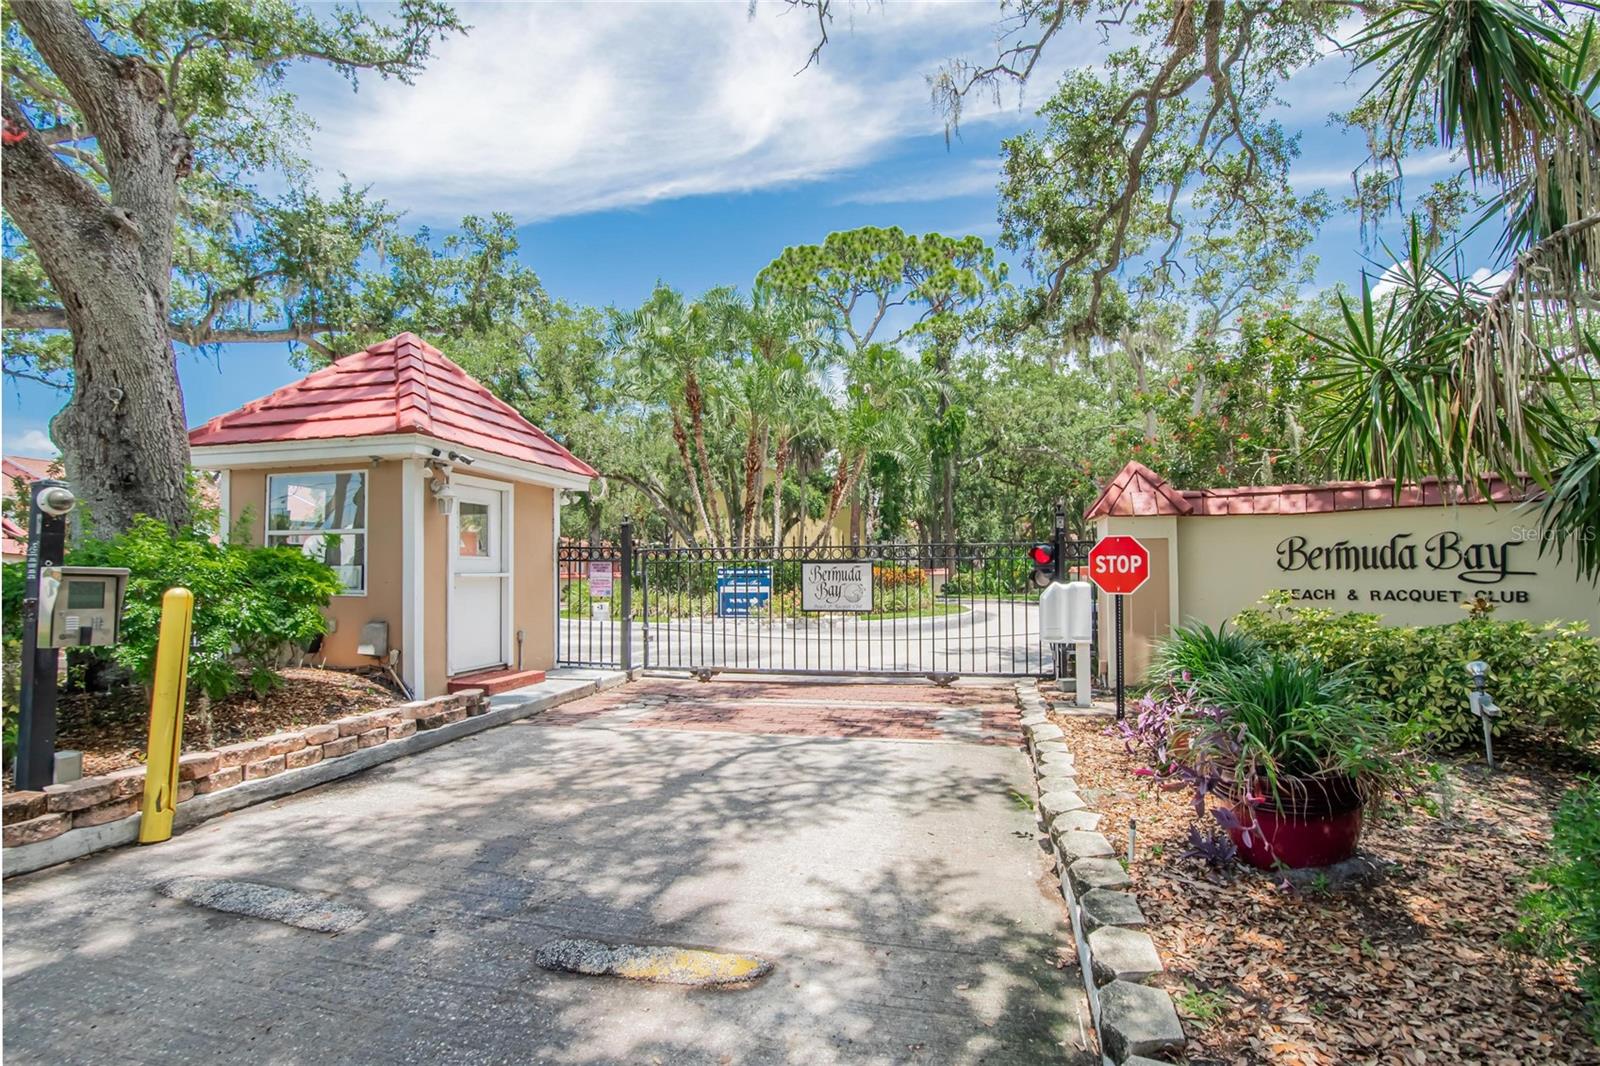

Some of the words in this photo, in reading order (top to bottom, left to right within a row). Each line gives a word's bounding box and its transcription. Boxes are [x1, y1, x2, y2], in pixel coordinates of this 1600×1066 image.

[1095, 555, 1142, 574] STOP
[1276, 532, 1417, 567] Bermuda
[1424, 531, 1537, 584] Bay
[808, 565, 862, 584] Bermuda
[814, 582, 846, 604] Bay
[1280, 589, 1335, 601] EACH
[1347, 589, 1359, 601] &
[1370, 590, 1461, 603] RACQUET
